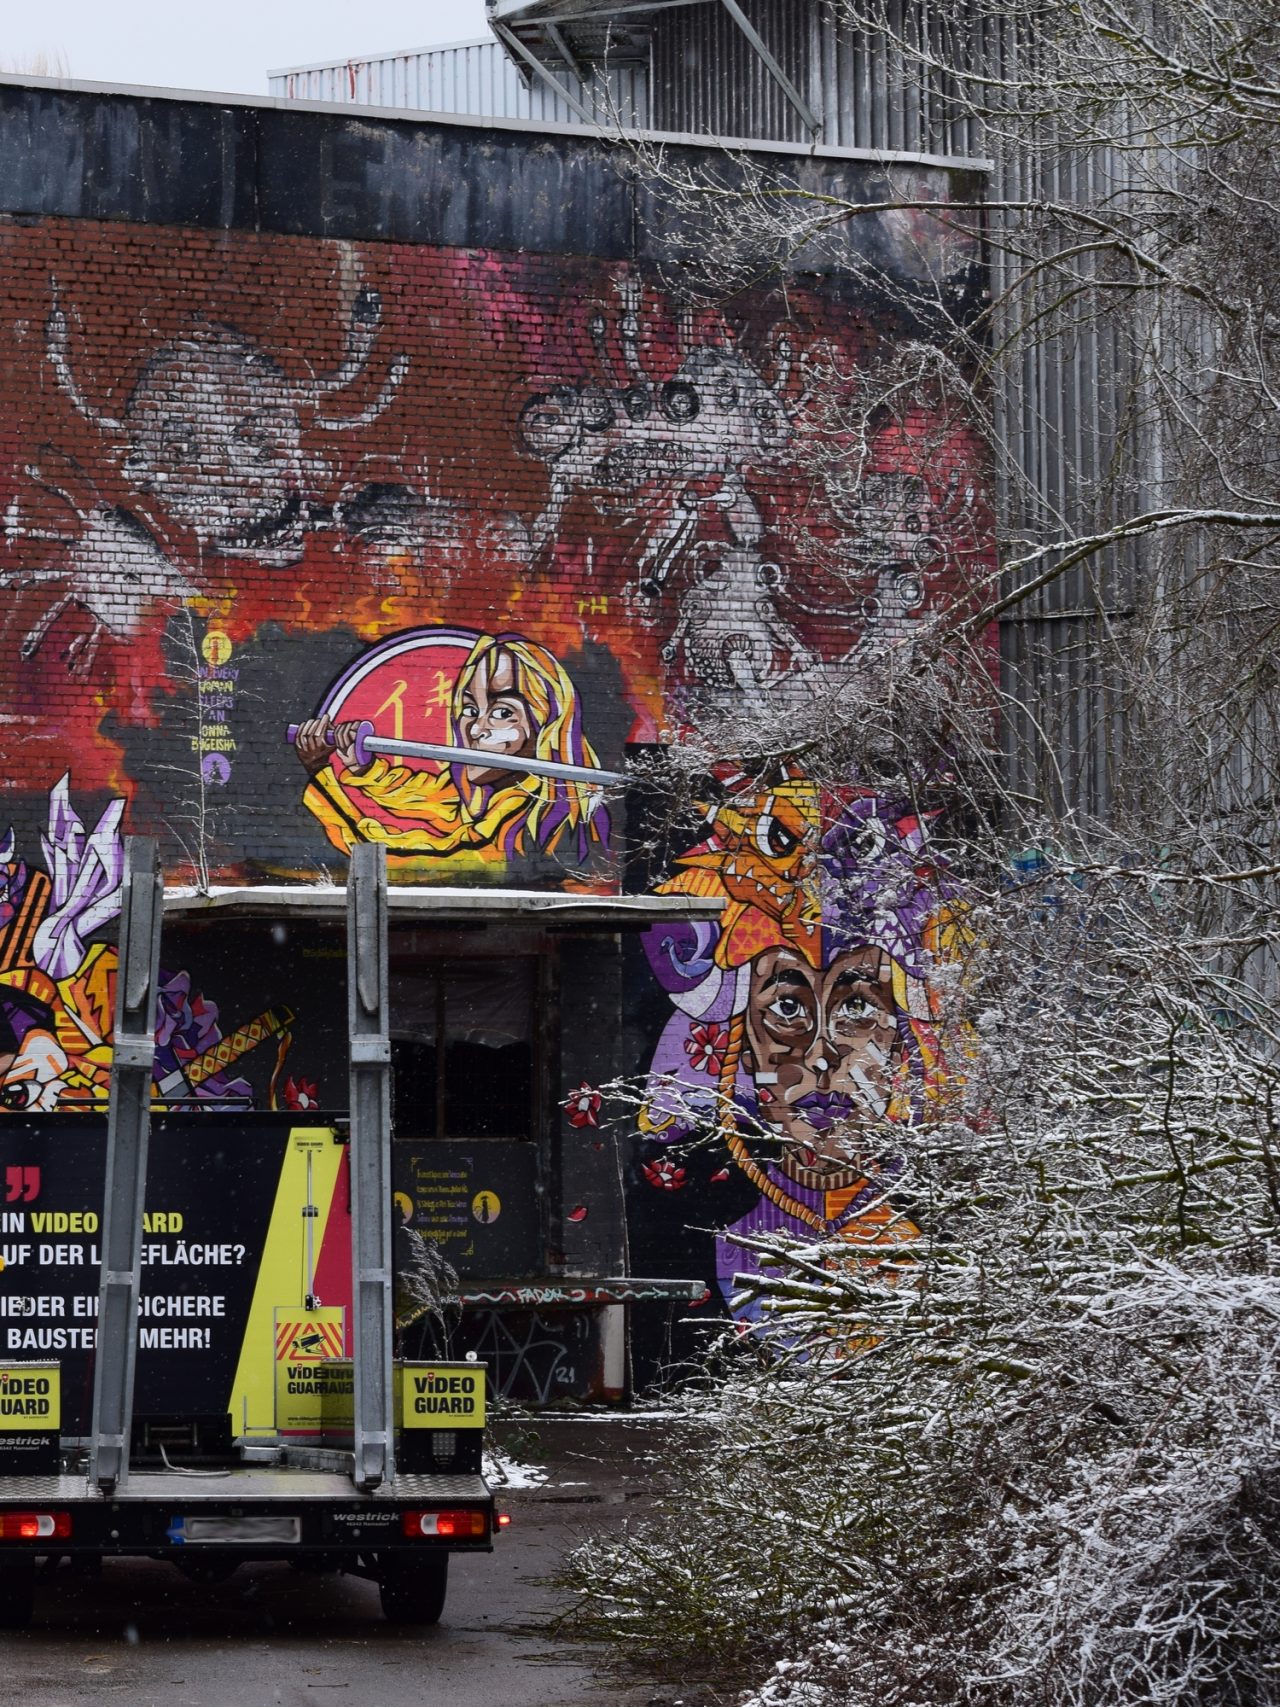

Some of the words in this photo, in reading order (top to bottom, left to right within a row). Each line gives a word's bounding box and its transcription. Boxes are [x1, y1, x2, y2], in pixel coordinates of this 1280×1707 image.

[208, 709, 225, 721] AN
[30, 1212, 99, 1233] VIDEO
[39, 1244, 84, 1265] DER
[139, 1328, 211, 1349] MEHR!
[414, 1397, 475, 1414] GUARD
[333, 1512, 400, 1521] westrick
